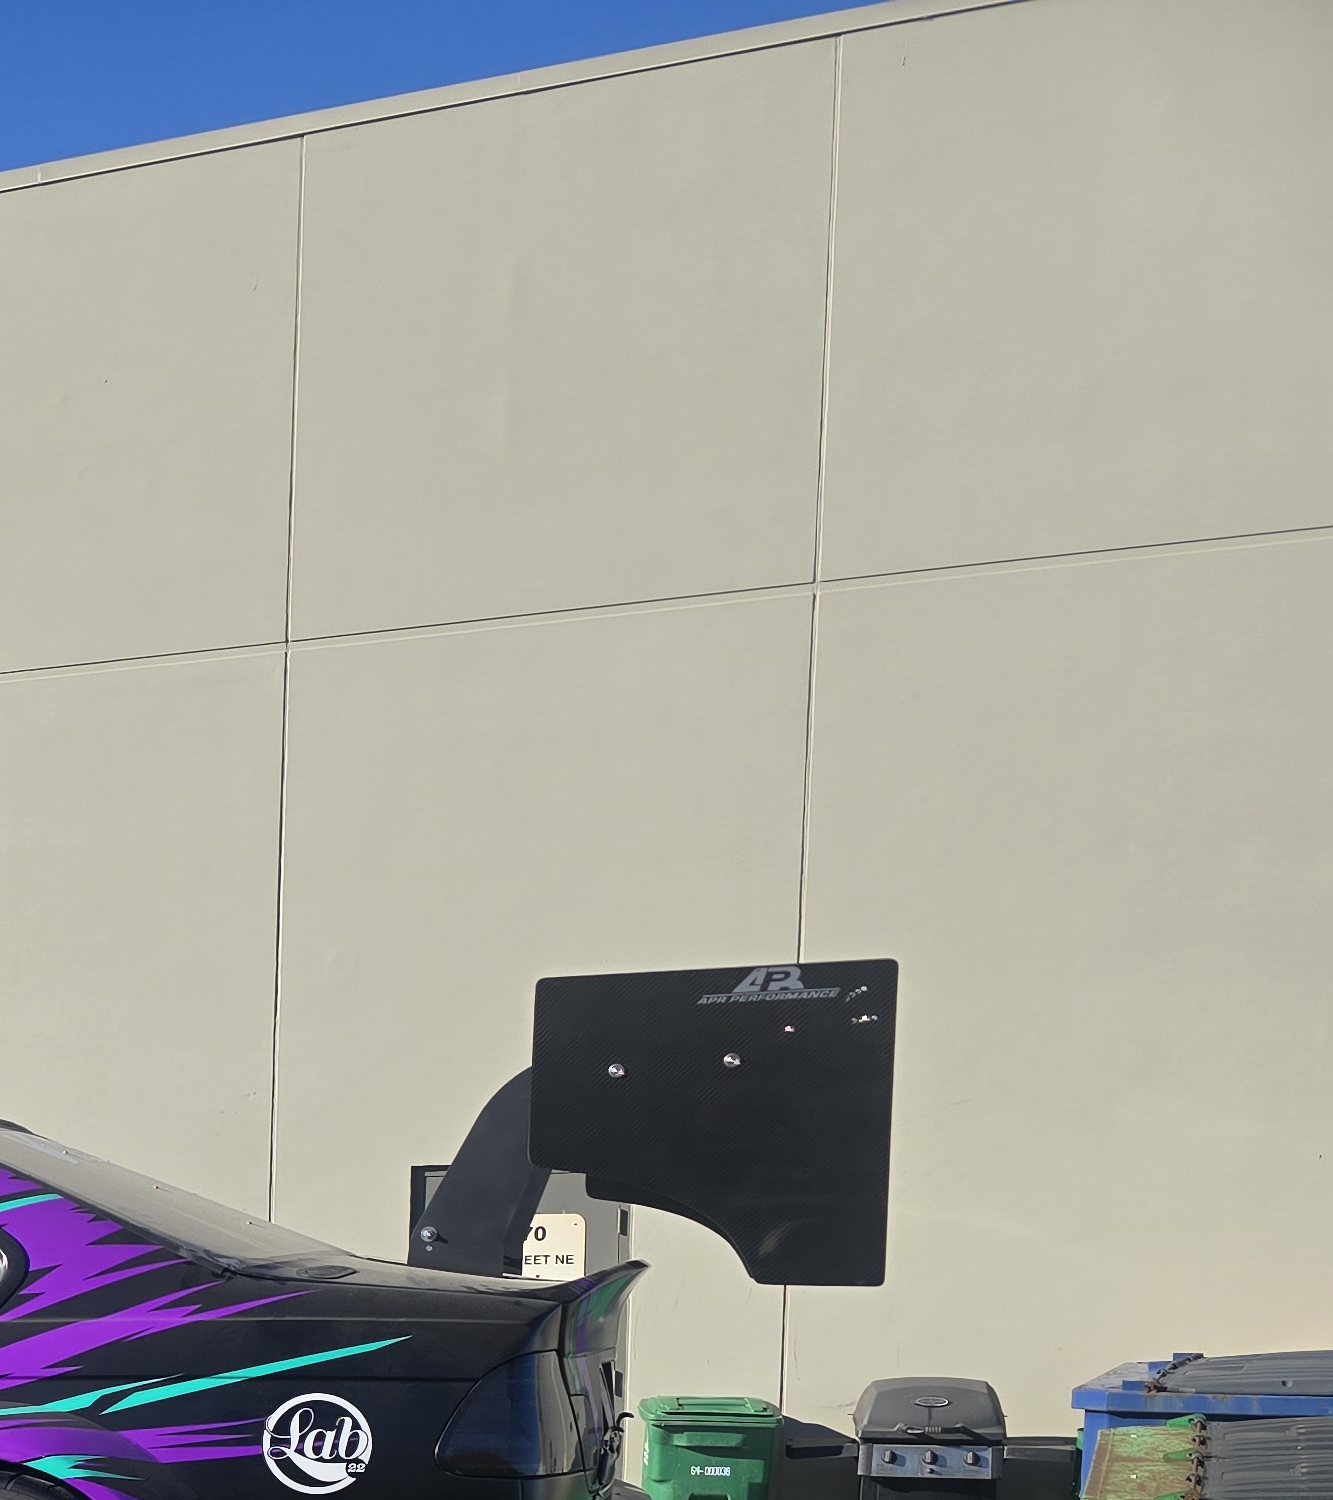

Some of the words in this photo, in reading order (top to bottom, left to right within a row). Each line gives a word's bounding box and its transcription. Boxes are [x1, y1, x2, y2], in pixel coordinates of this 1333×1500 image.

[729, 990, 837, 1004] PERFORMANCE
[524, 1254, 550, 1265] EET
[555, 1254, 574, 1265] NE
[347, 1462, 367, 1473] 22
